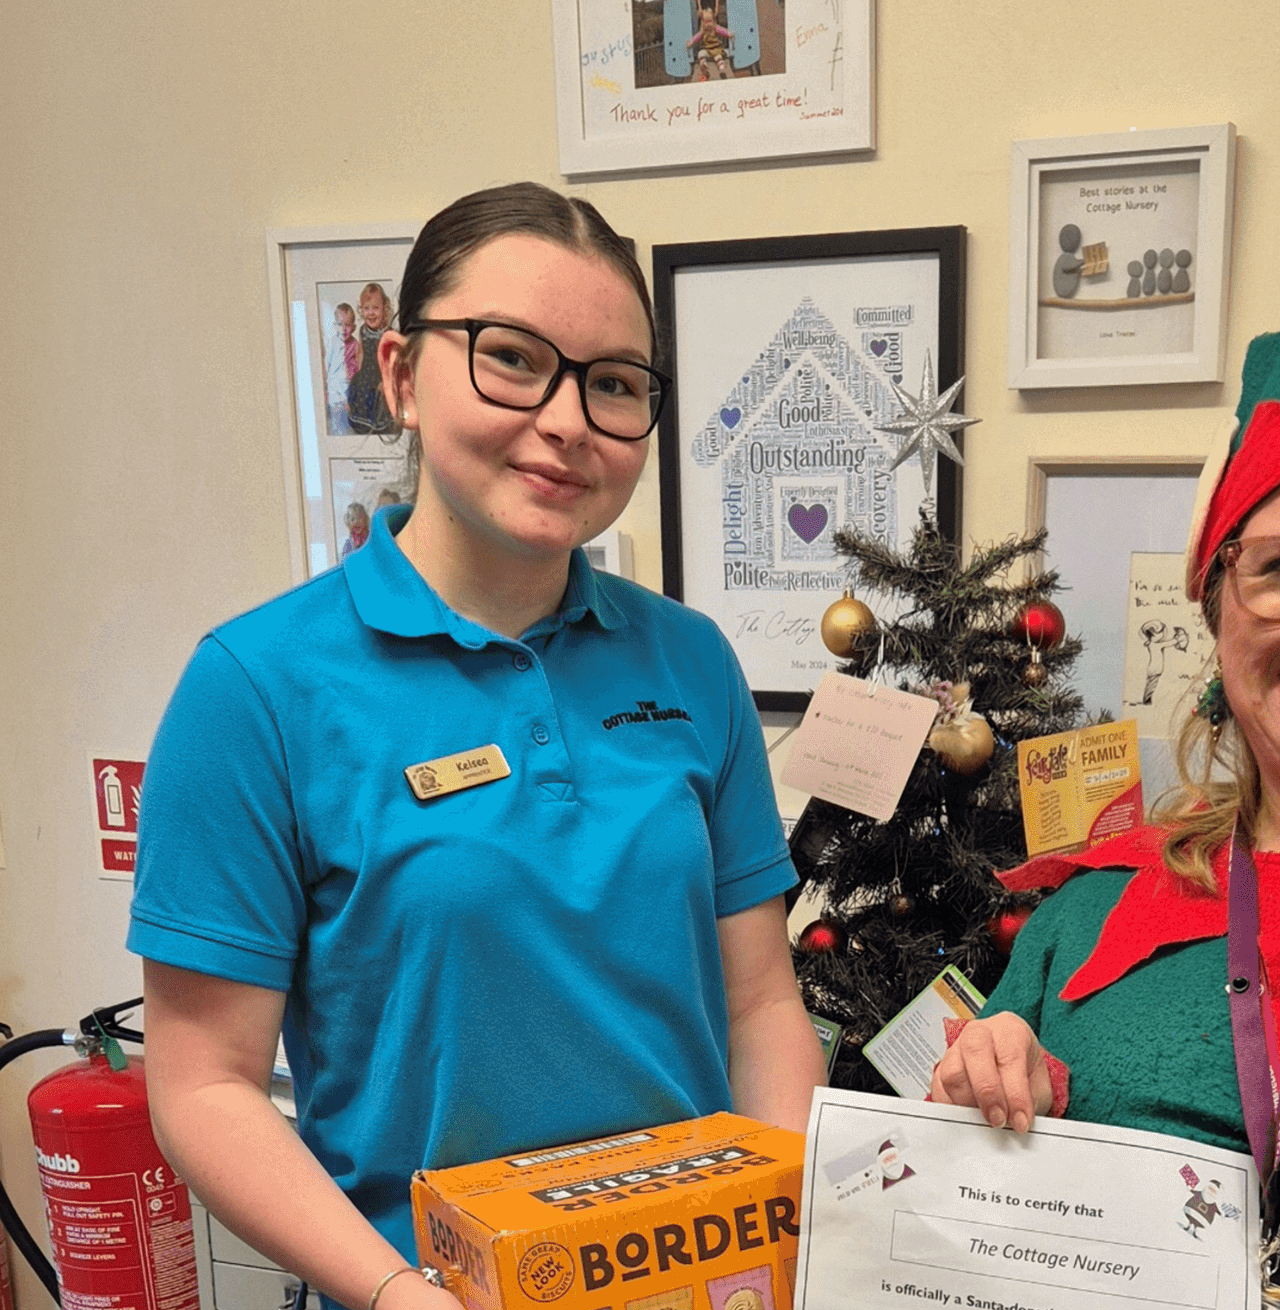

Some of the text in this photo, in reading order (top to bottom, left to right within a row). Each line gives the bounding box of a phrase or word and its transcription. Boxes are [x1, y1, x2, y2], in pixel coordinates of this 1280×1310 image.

[610, 87, 808, 125] Thank you for a great time!
[1080, 184, 1167, 198] Best stories at the
[1086, 201, 1159, 213] Cottage Nursery
[856, 305, 912, 326] Committed
[883, 332, 903, 373] Good
[801, 369, 813, 403] Polite
[779, 397, 821, 429] Good
[750, 439, 867, 474] Outstanding
[723, 479, 747, 556] Delight
[872, 469, 893, 542] scovery
[724, 560, 769, 591] Polite
[786, 571, 842, 591] Reflective
[809, 660, 827, 669] 2024
[1080, 734, 1106, 748] ADMIT
[1081, 744, 1128, 766] FAMILY
[455, 756, 489, 773] Kelsea
[113, 850, 136, 861] WAT
[546, 1149, 745, 1202] FRAGILE
[958, 1186, 1104, 1218] This is to certify that
[579, 1197, 800, 1293] BORDER
[969, 1238, 1140, 1280] The Cottage Nursery
[530, 1256, 555, 1281] NEW
[534, 1261, 565, 1291] LOOK
[881, 1280, 892, 1292] is
[895, 1284, 950, 1305] officially
[954, 1296, 962, 1304] a
